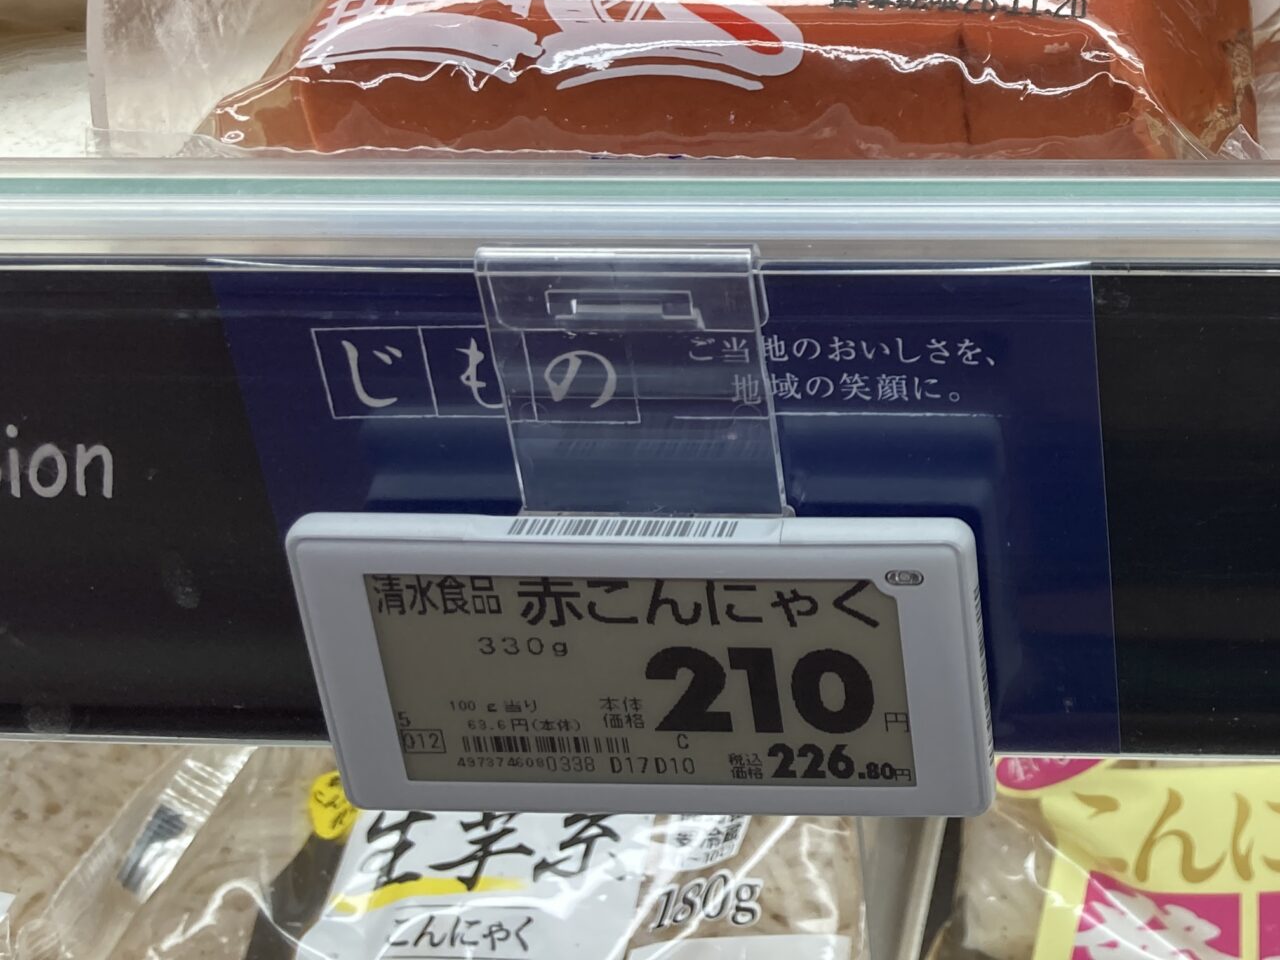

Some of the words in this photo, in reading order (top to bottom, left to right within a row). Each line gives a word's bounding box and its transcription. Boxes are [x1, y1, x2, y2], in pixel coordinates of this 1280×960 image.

[731, 372, 960, 405] 地域の笑顔に。
[376, 576, 502, 617] 清水食品
[519, 579, 879, 628] 赤こんにゃく
[479, 638, 568, 658] 330g
[600, 697, 643, 712] 本体
[645, 646, 874, 733] 210
[884, 711, 909, 733] 円
[603, 714, 645, 730] 価格
[676, 733, 689, 750] C
[655, 873, 762, 925] 180g
[388, 915, 535, 950] こんにゃく
